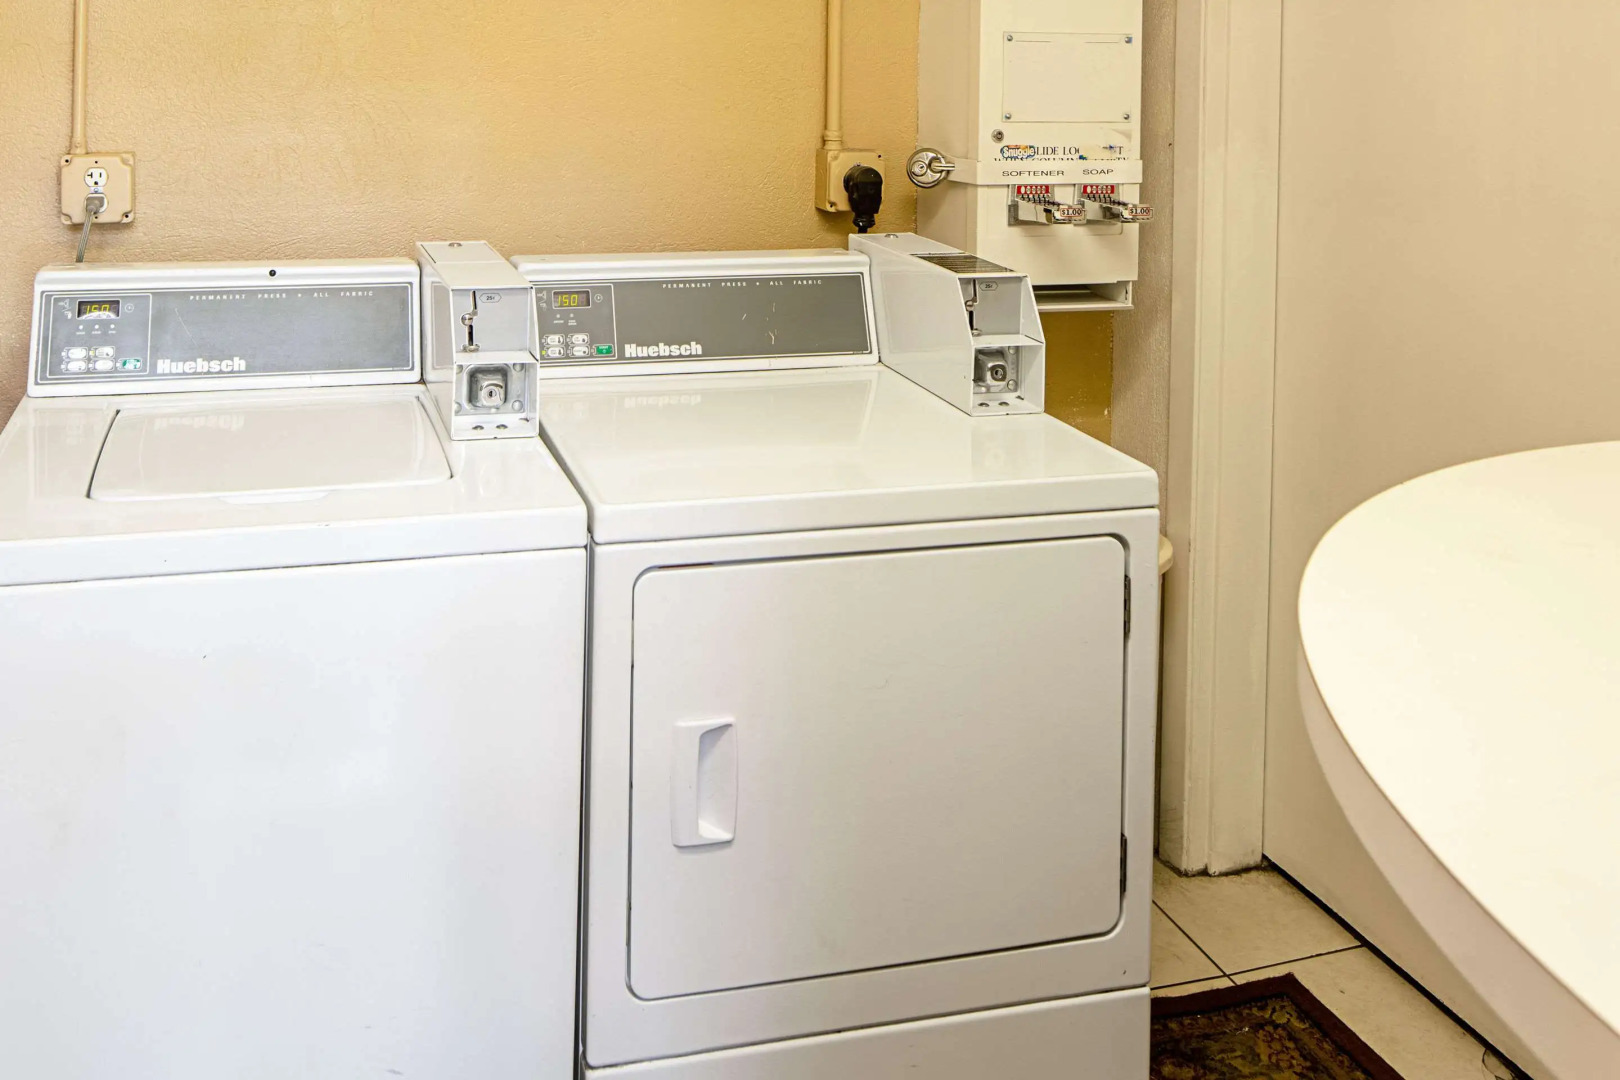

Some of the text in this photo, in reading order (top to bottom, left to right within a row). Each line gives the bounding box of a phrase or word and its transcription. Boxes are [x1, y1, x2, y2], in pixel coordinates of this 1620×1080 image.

[1036, 146, 1059, 155] LIDE
[1061, 208, 1082, 216] $1.00
[1129, 207, 1150, 215] $1.00
[557, 294, 578, 306] 150
[624, 341, 703, 358] Huebsch
[157, 357, 246, 374] Huebsch
